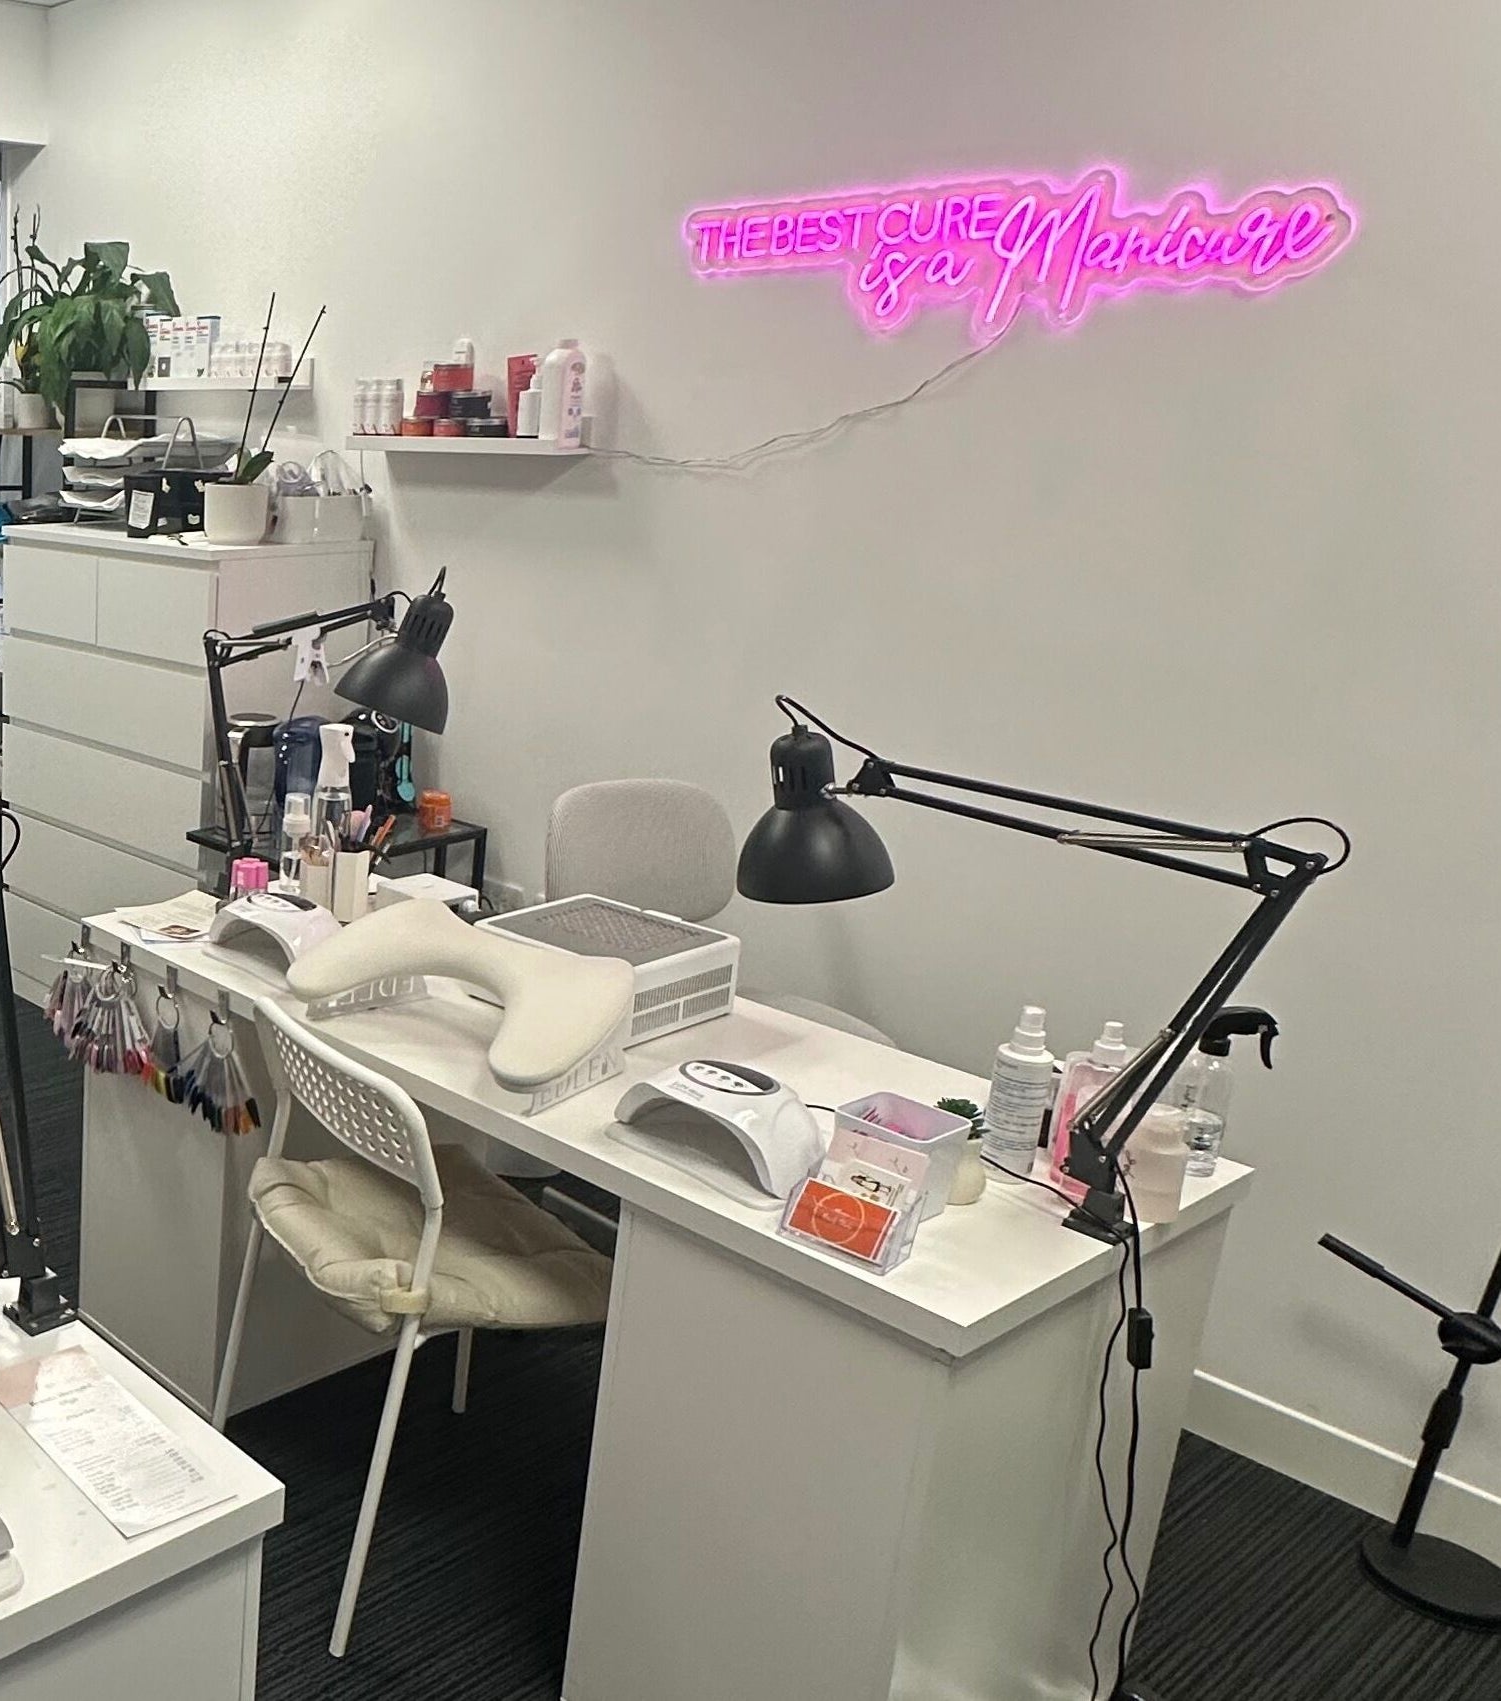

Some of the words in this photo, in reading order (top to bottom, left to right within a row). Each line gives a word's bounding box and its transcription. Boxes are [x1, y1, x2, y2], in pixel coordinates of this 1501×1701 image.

[691, 216, 769, 264] THE
[769, 204, 878, 257] BEST
[875, 193, 1008, 247] CURE
[859, 242, 926, 317] is
[924, 249, 975, 287] a
[985, 184, 1335, 323] Manicure
